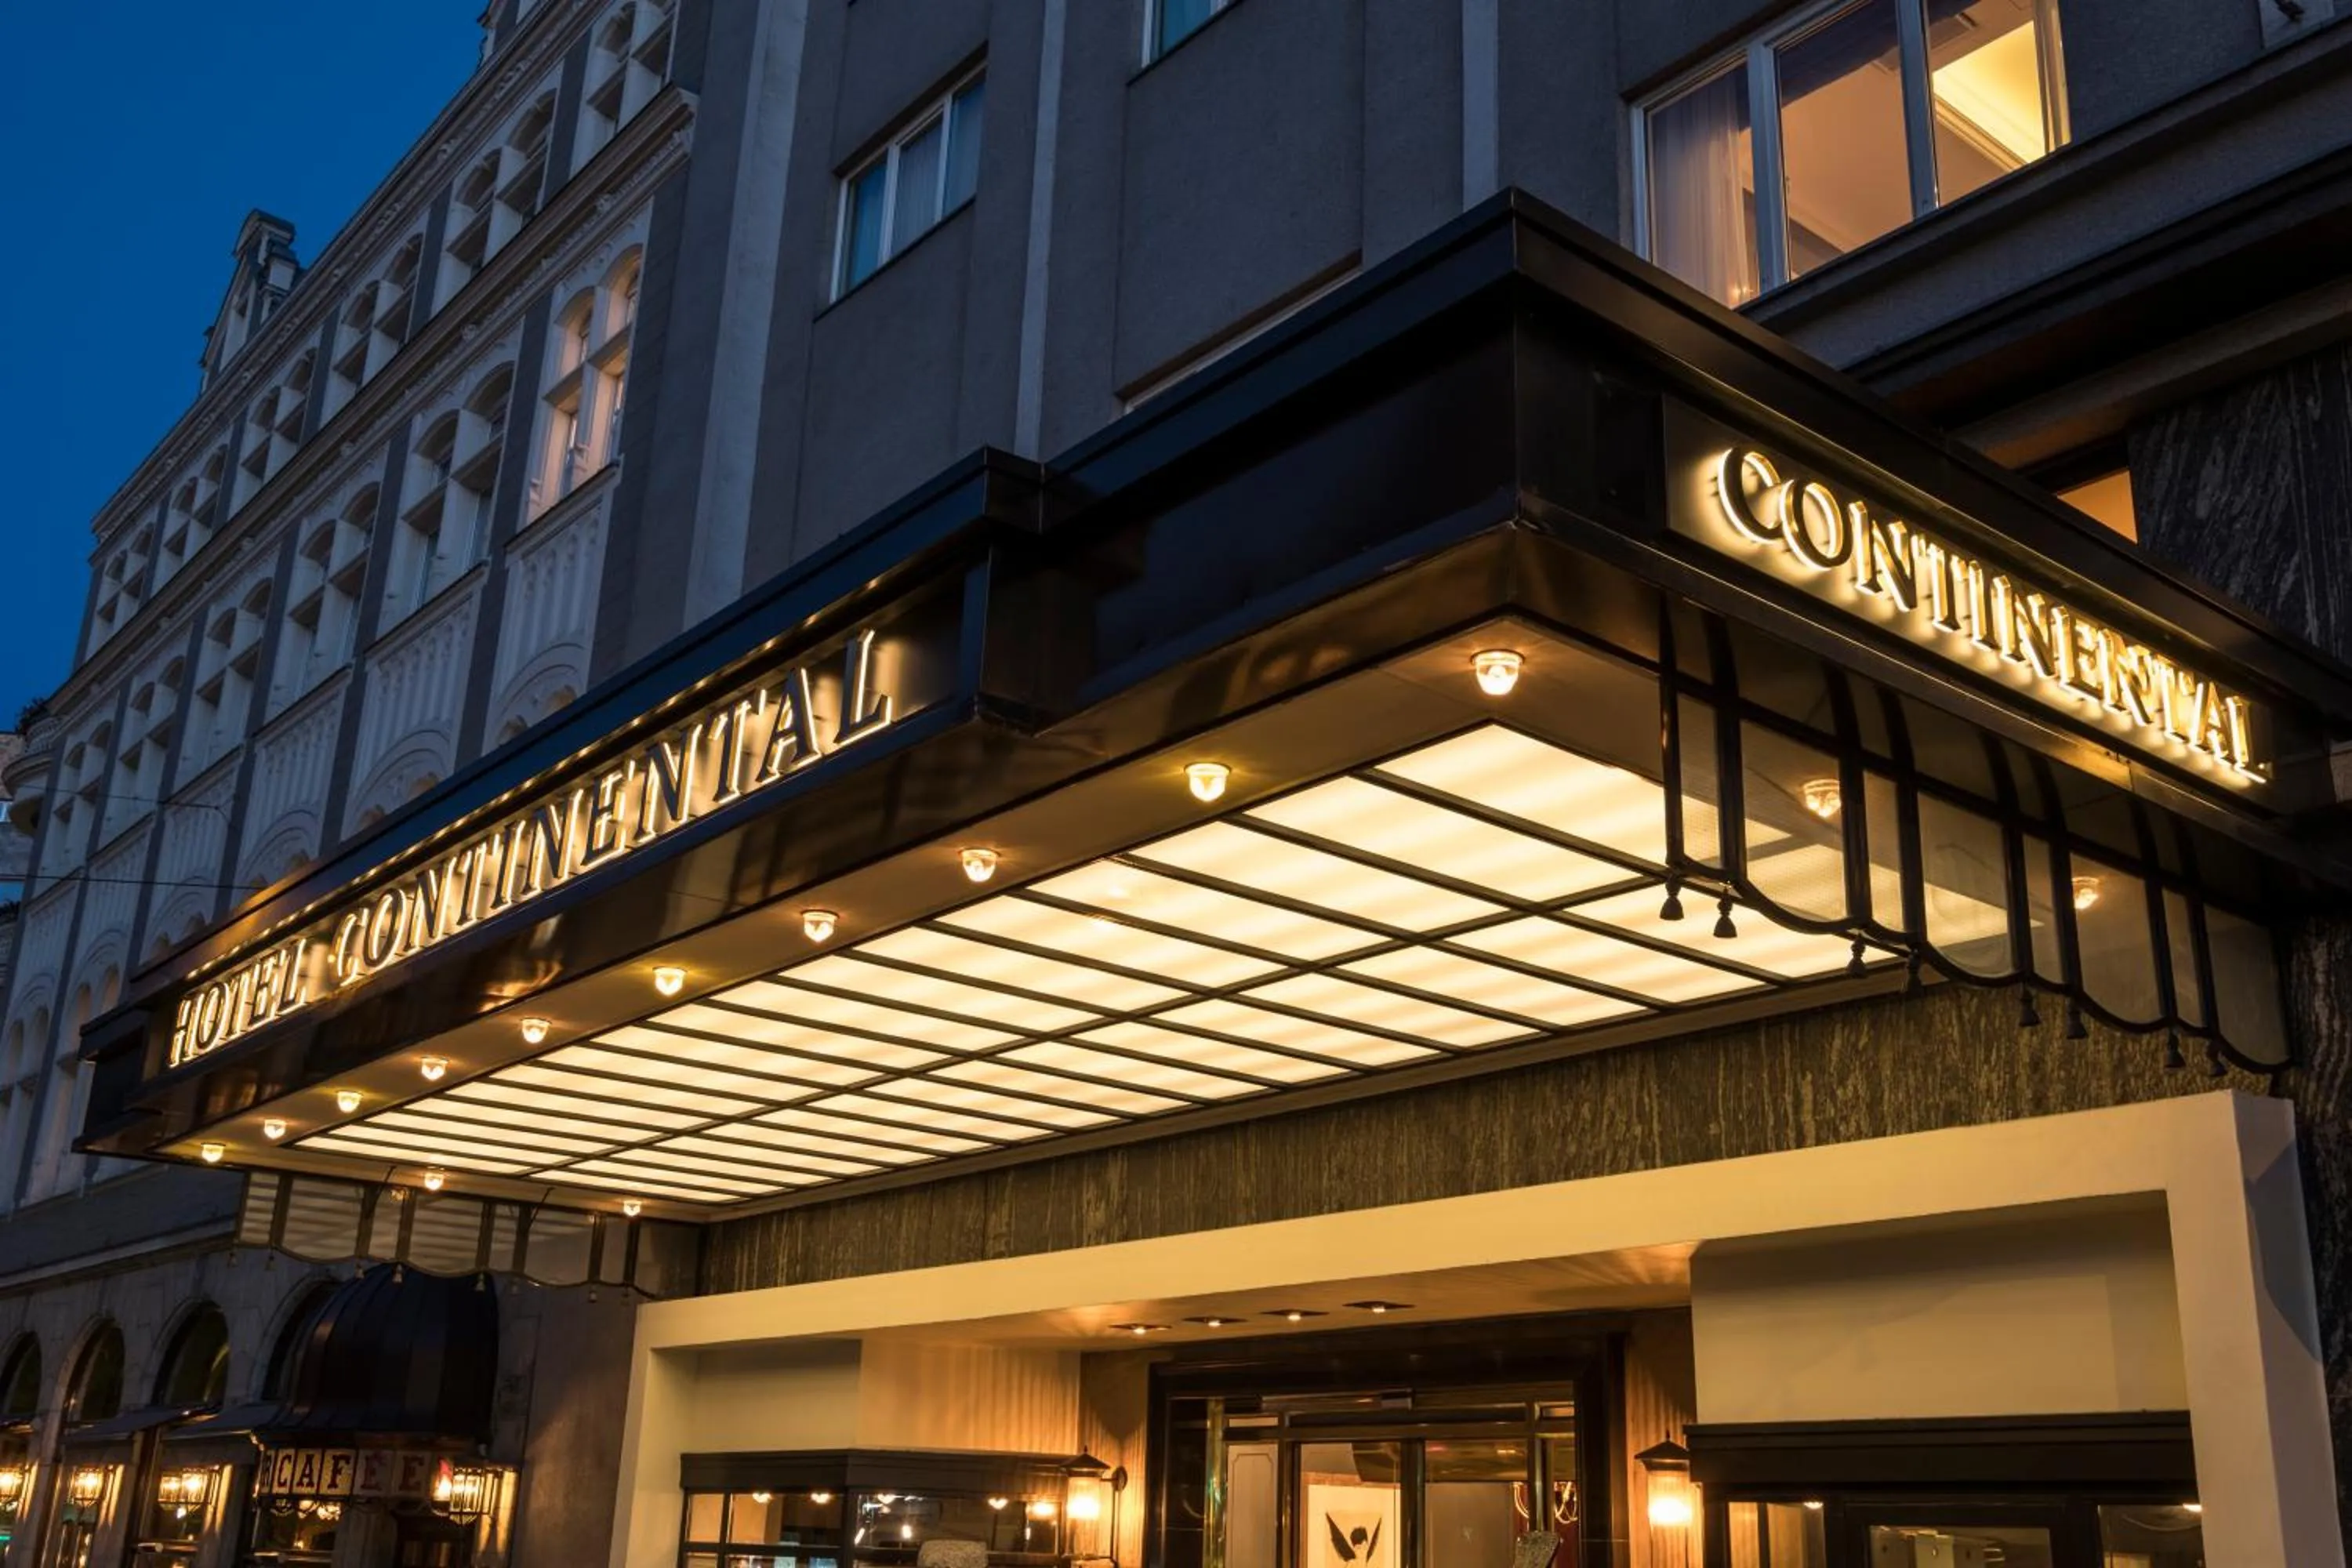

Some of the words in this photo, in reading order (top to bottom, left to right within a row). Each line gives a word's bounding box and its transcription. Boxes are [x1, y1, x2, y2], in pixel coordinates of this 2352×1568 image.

[1717, 445, 2270, 783] CONTINENTAL
[168, 938, 307, 1068] HOTEL
[332, 629, 892, 987] CONTINENTAL
